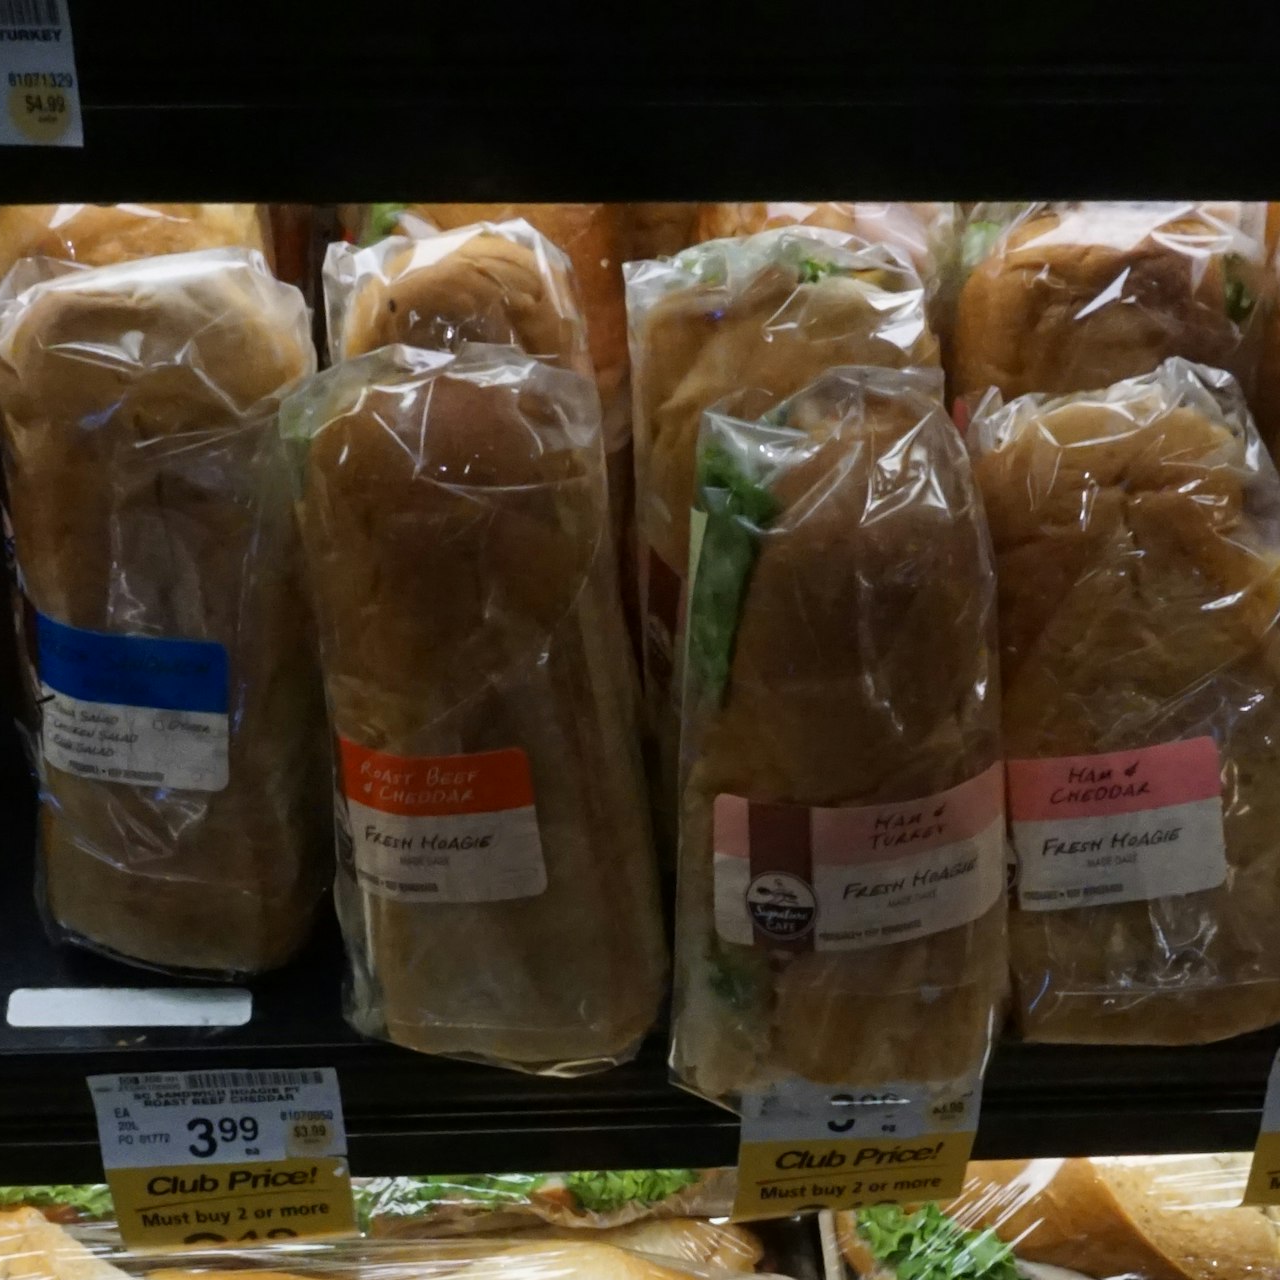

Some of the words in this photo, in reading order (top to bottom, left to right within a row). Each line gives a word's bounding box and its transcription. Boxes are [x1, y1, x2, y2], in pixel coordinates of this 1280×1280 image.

[360, 760, 413, 784] ROAST
[426, 768, 480, 785] BEEF
[1069, 768, 1113, 783] HAM
[379, 787, 476, 804] CHEDDAR
[1050, 782, 1151, 804] CHEDDAR
[875, 812, 922, 829] HAM
[365, 825, 413, 849] FRESH
[421, 834, 494, 850] HOAGIE
[871, 824, 945, 849] TURKEY
[1042, 838, 1104, 856] FRESH
[1112, 828, 1183, 849] HOAGIE
[843, 878, 905, 899] FRESH
[913, 857, 978, 887] HOAGIE
[114, 1108, 130, 1118] EA
[144, 1099, 186, 1108] ROAST
[192, 1096, 225, 1105] BEEF
[231, 1094, 294, 1104] CHEDDAR
[775, 1150, 846, 1169] Club
[853, 1142, 944, 1166] Price!
[147, 1173, 218, 1197] Club
[228, 1167, 318, 1191] Price!
[760, 1186, 807, 1200] Must
[812, 1183, 846, 1199] buy
[852, 1181, 862, 1193] 2
[869, 1181, 887, 1193] or
[894, 1176, 942, 1191] more
[142, 1211, 191, 1227] Must
[196, 1208, 230, 1226] buy
[237, 1207, 248, 1220] 2
[255, 1206, 273, 1219] or
[280, 1201, 330, 1216] more
